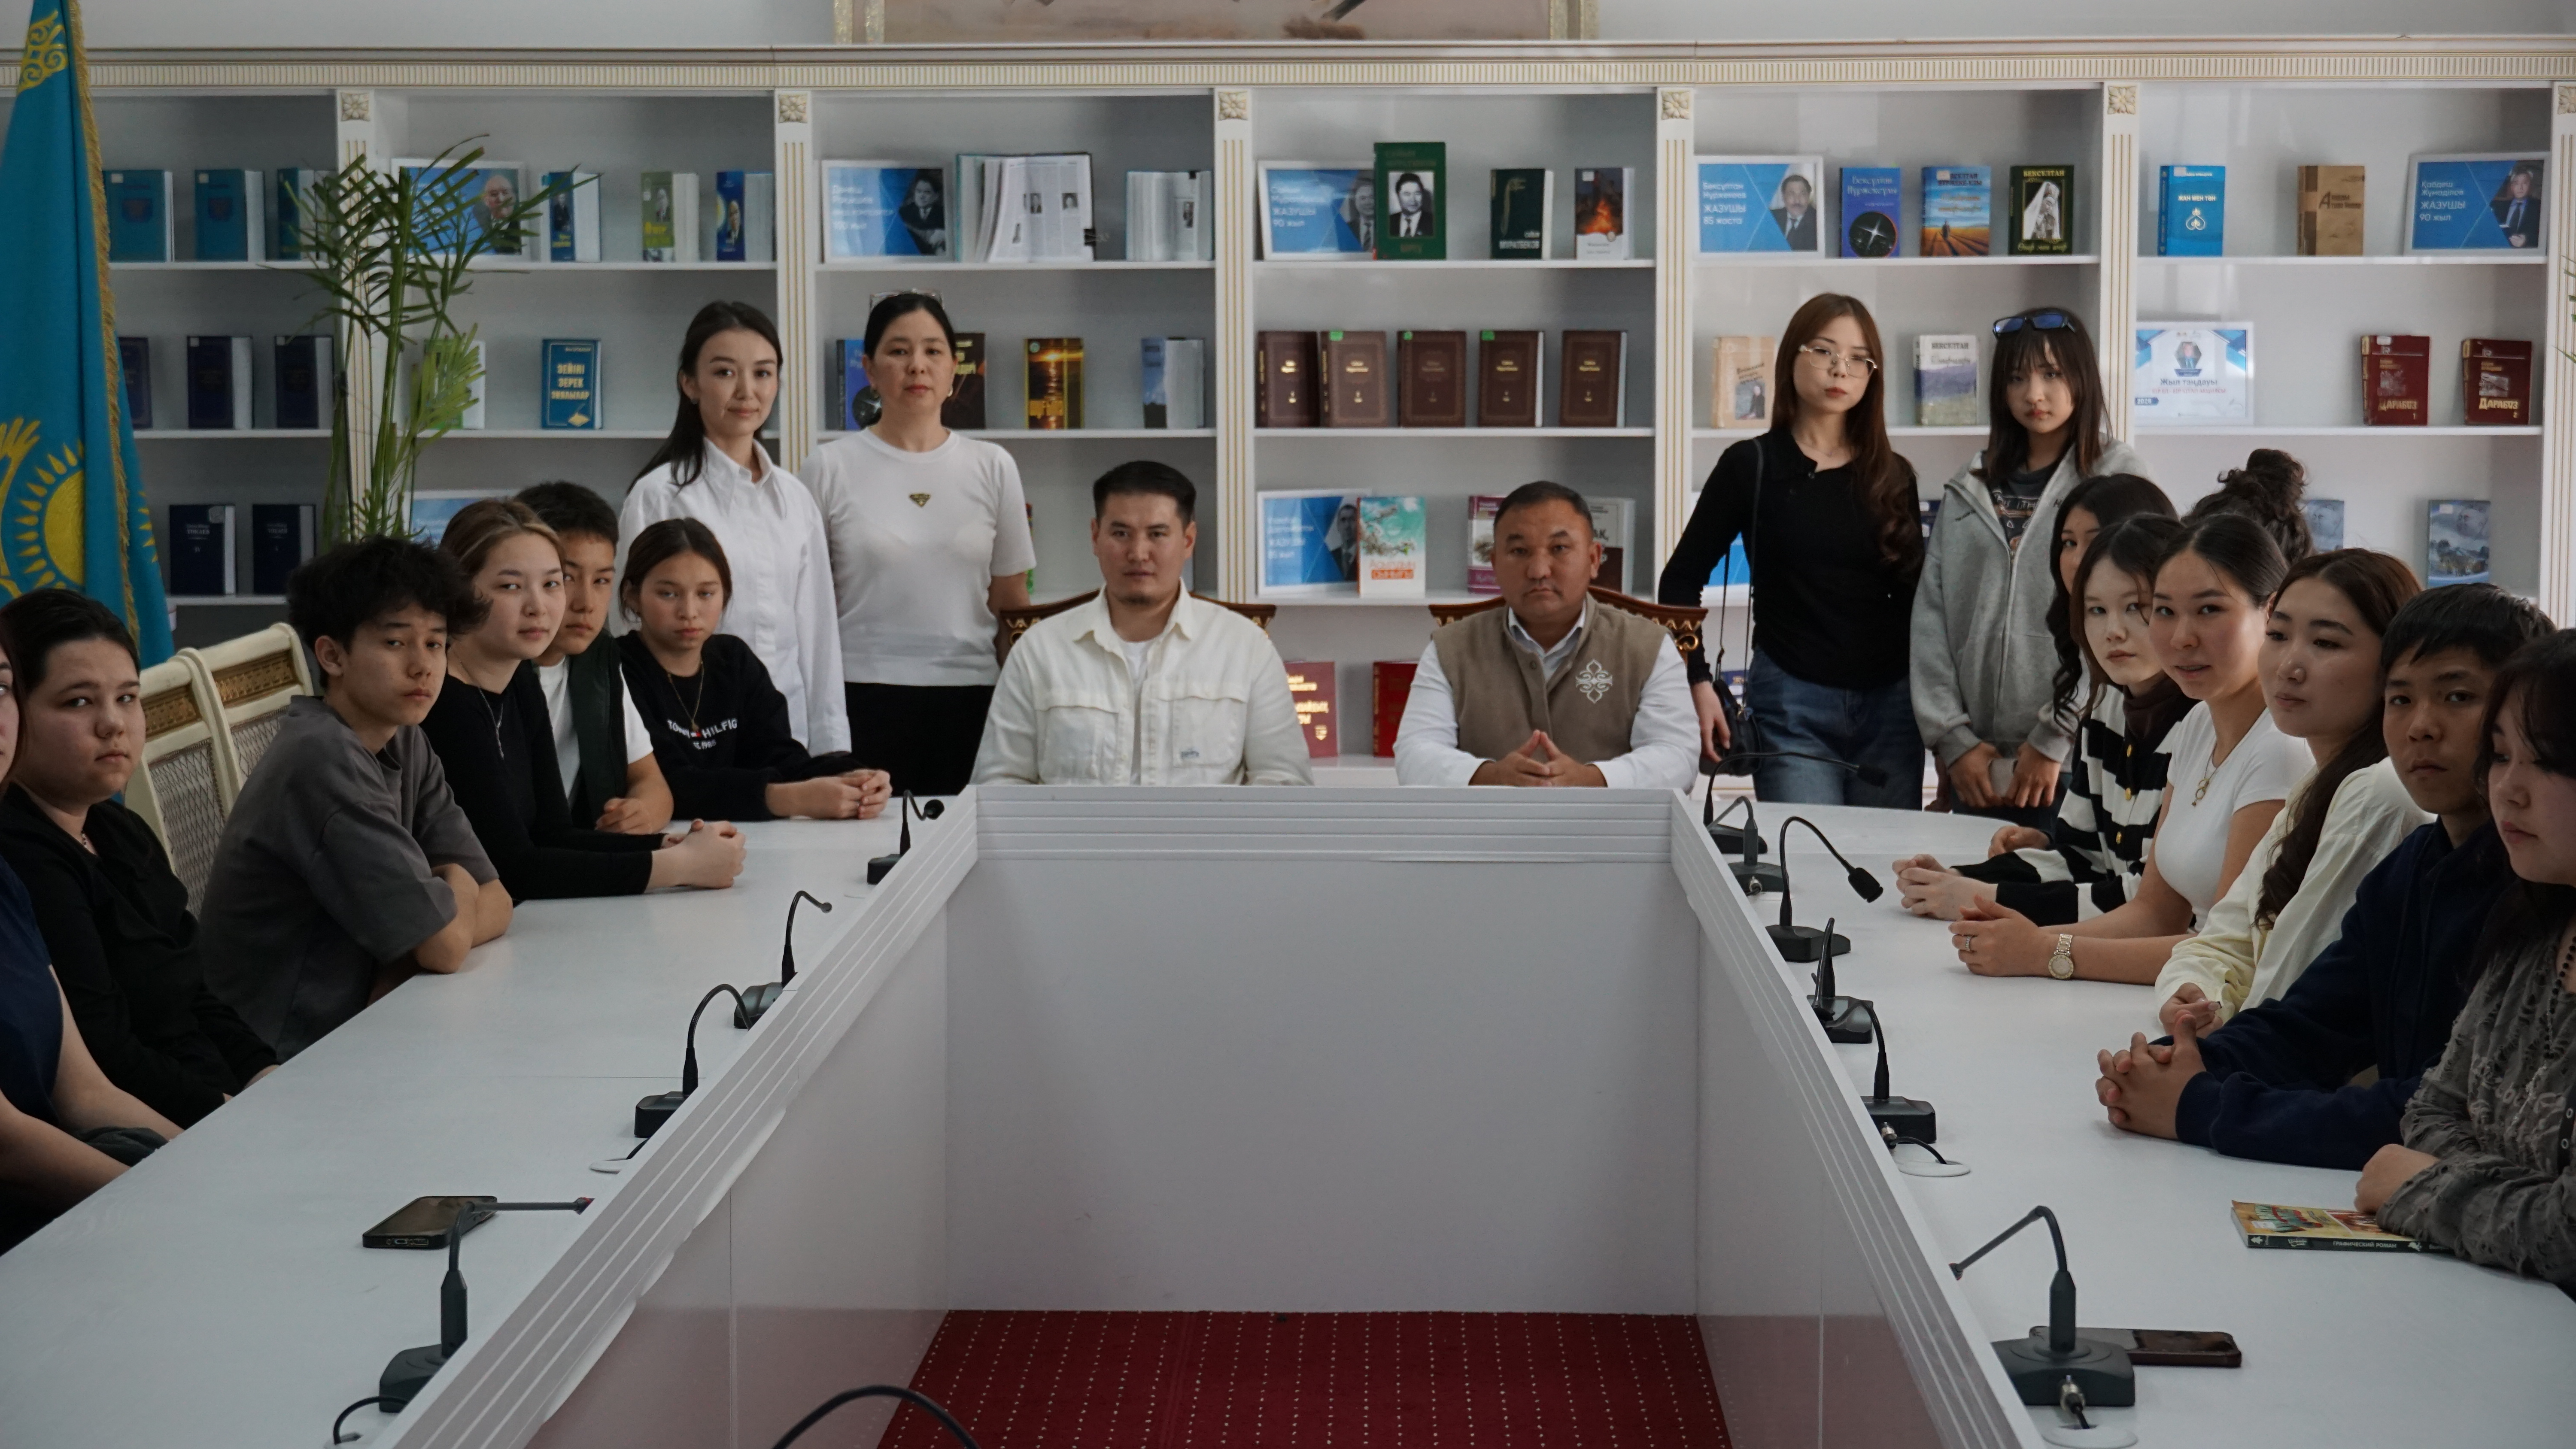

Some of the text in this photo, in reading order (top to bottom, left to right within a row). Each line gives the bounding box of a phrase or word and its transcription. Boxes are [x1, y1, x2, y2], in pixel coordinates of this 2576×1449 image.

[2421, 201, 2465, 209] ЖАЗУШЫ
[1704, 217, 1713, 225] 85
[2420, 213, 2430, 221] 90
[667, 719, 690, 739] TOMMY
